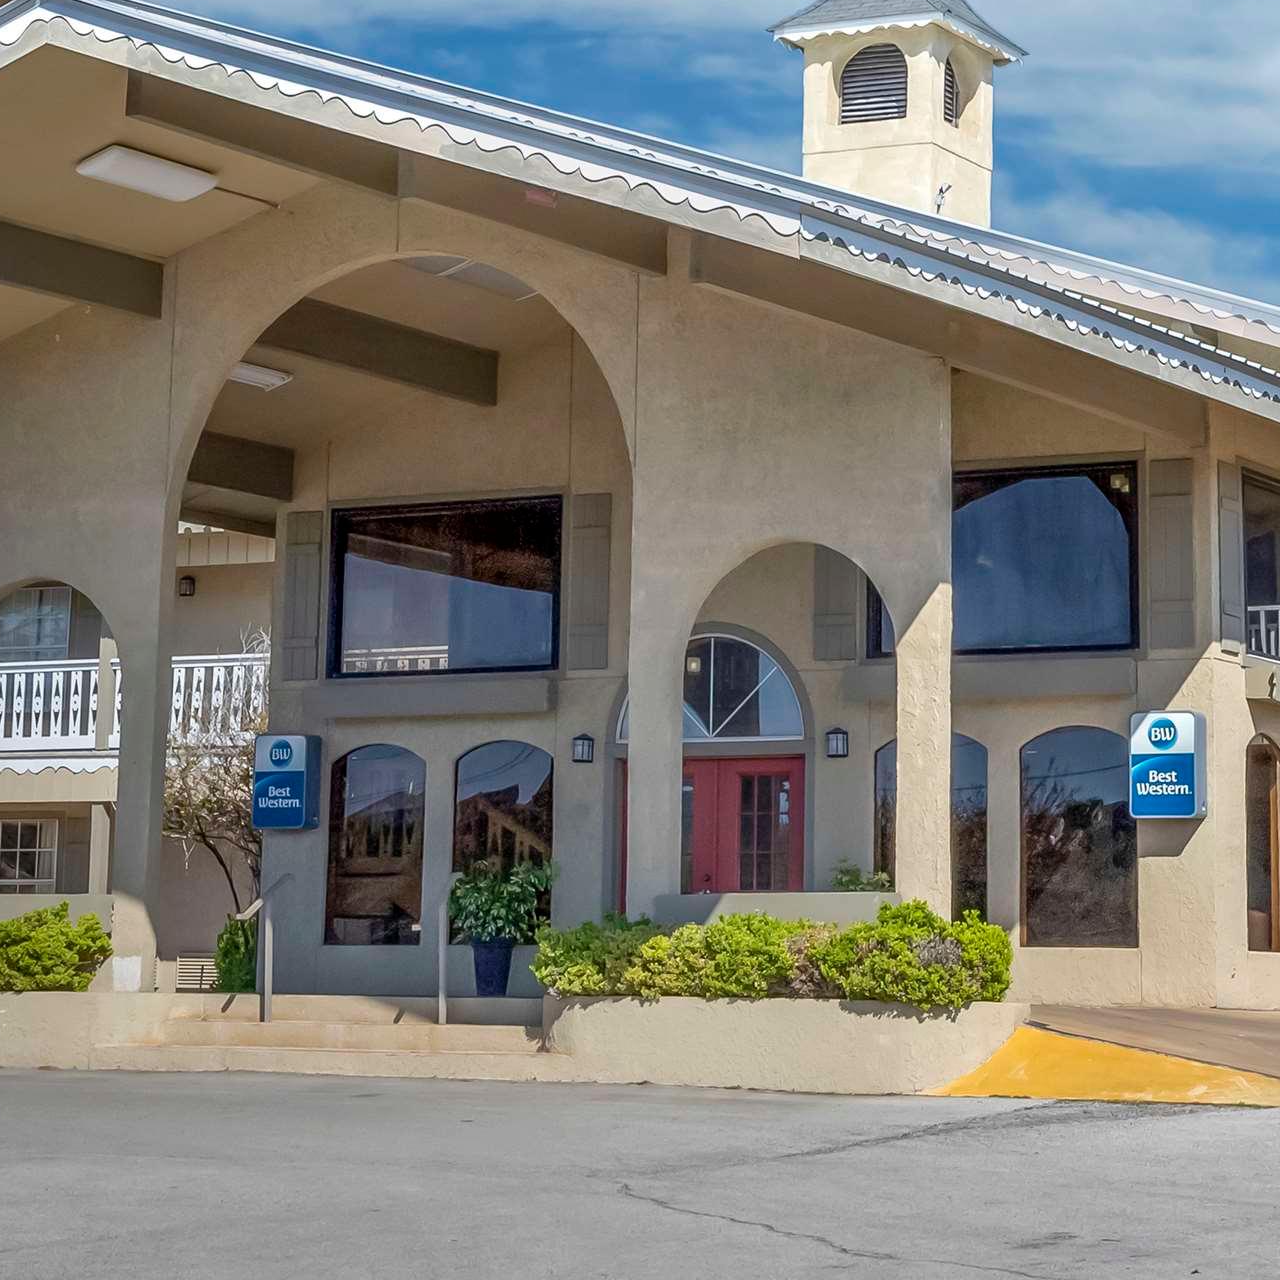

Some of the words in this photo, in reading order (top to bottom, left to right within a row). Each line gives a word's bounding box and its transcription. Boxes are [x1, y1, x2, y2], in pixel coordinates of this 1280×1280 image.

[1151, 727, 1175, 741] BW
[272, 748, 291, 760] BW
[1149, 770, 1177, 782] Best
[268, 786, 291, 797] Best
[258, 798, 300, 808] Western
